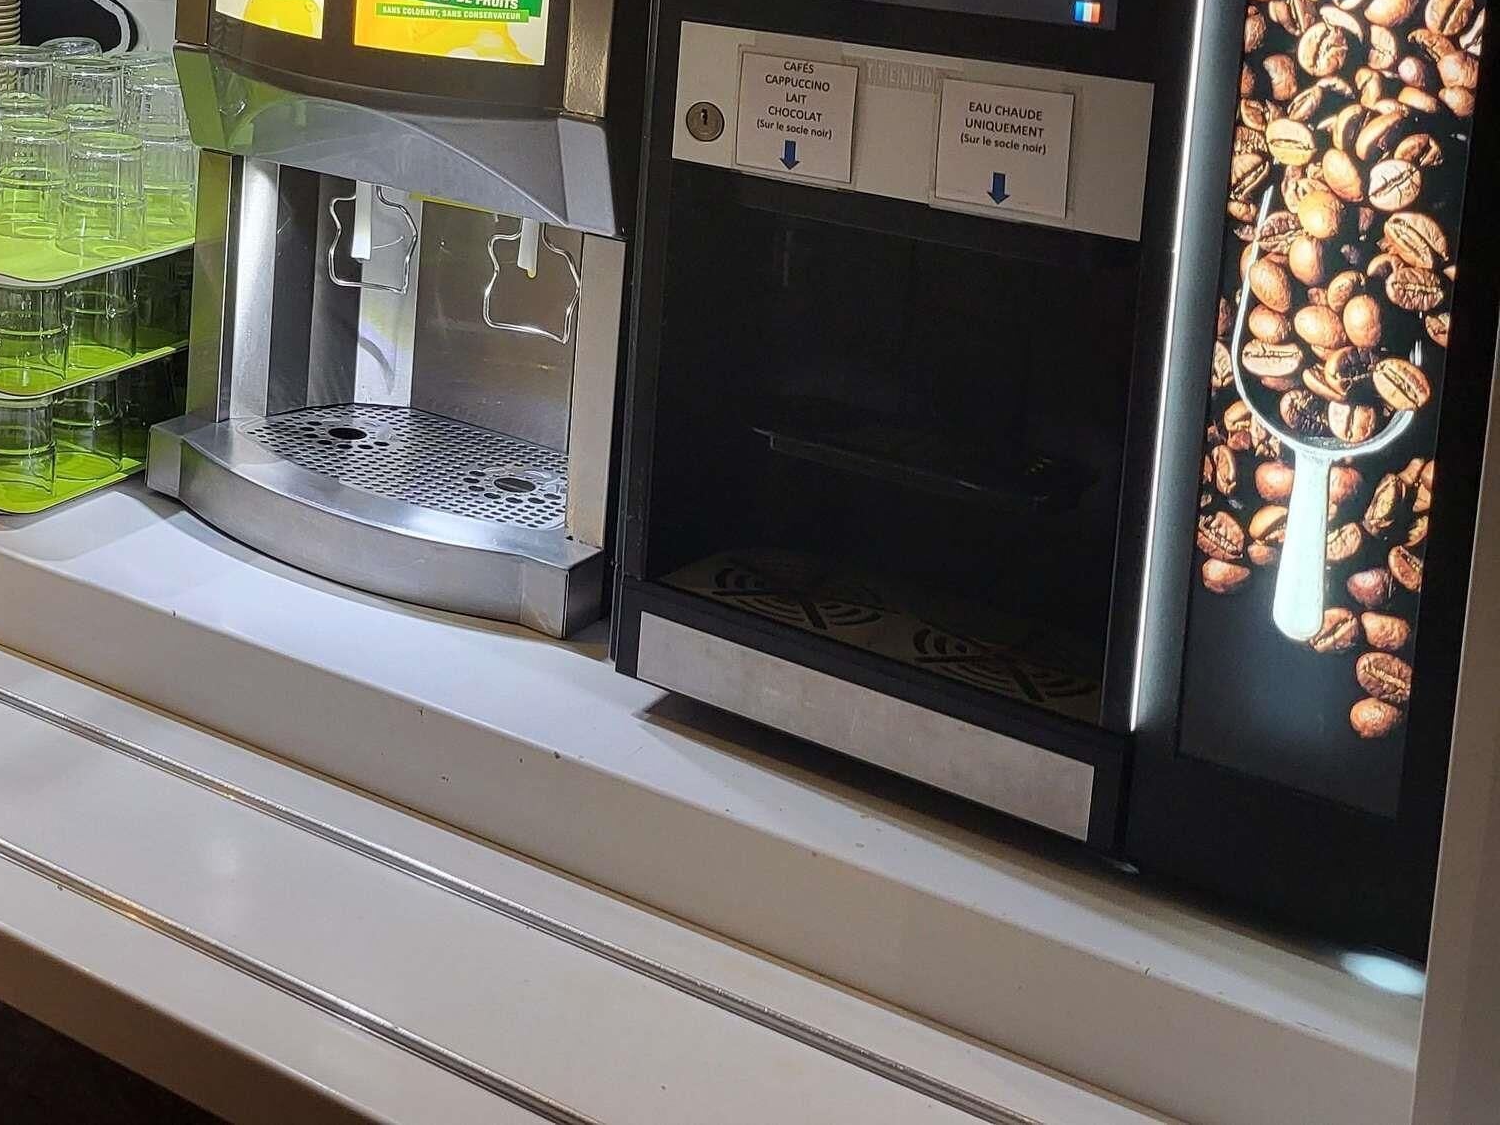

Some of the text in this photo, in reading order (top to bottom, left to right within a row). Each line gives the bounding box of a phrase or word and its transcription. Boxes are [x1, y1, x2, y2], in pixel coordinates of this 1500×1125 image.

[382, 6, 401, 15] SANS
[441, 9, 462, 18] SANS
[463, 10, 521, 20] CONSERVATEUR
[765, 74, 830, 92] CAPPUCCINO
[785, 92, 807, 104] LAIT
[768, 105, 822, 122] CHOCOLAT
[969, 101, 1043, 121] EAU CHAUDE
[756, 118, 832, 140] (Sur le socle noir)
[965, 118, 1044, 139] UNIQUEMENT
[960, 132, 1046, 155] (Sur le socle noir)
